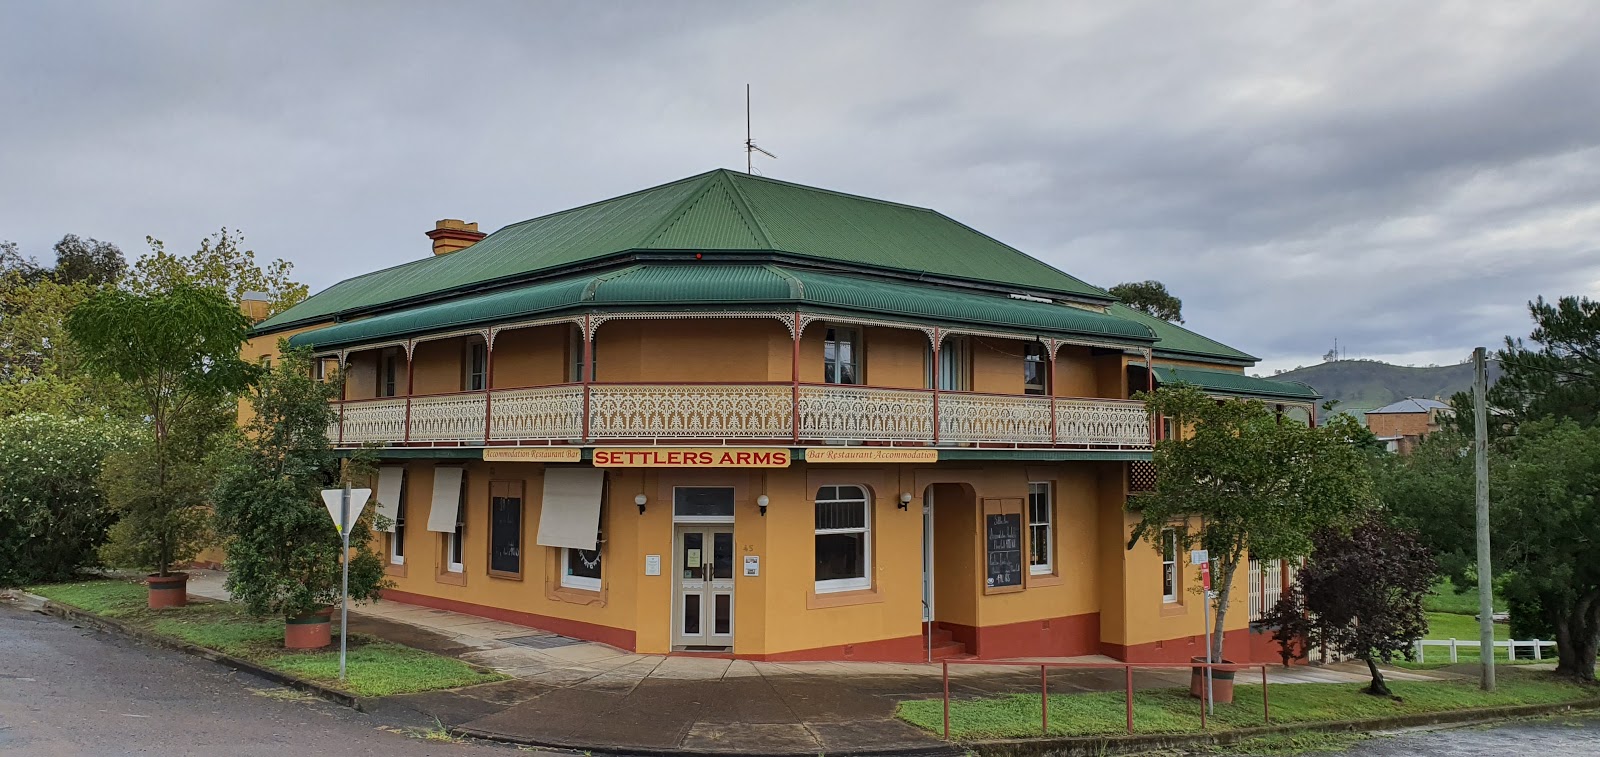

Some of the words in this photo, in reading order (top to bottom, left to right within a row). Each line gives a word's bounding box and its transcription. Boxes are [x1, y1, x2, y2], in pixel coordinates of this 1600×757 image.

[485, 448, 530, 458] Accommodation
[531, 449, 564, 459] Restaurant
[566, 450, 578, 458] Bar
[595, 451, 713, 465] SETTLERS
[719, 452, 787, 465] ARMS
[807, 450, 825, 459] Bar
[827, 450, 873, 460] Restaurant
[873, 450, 936, 459] Accommodation
[743, 544, 754, 552] 45
